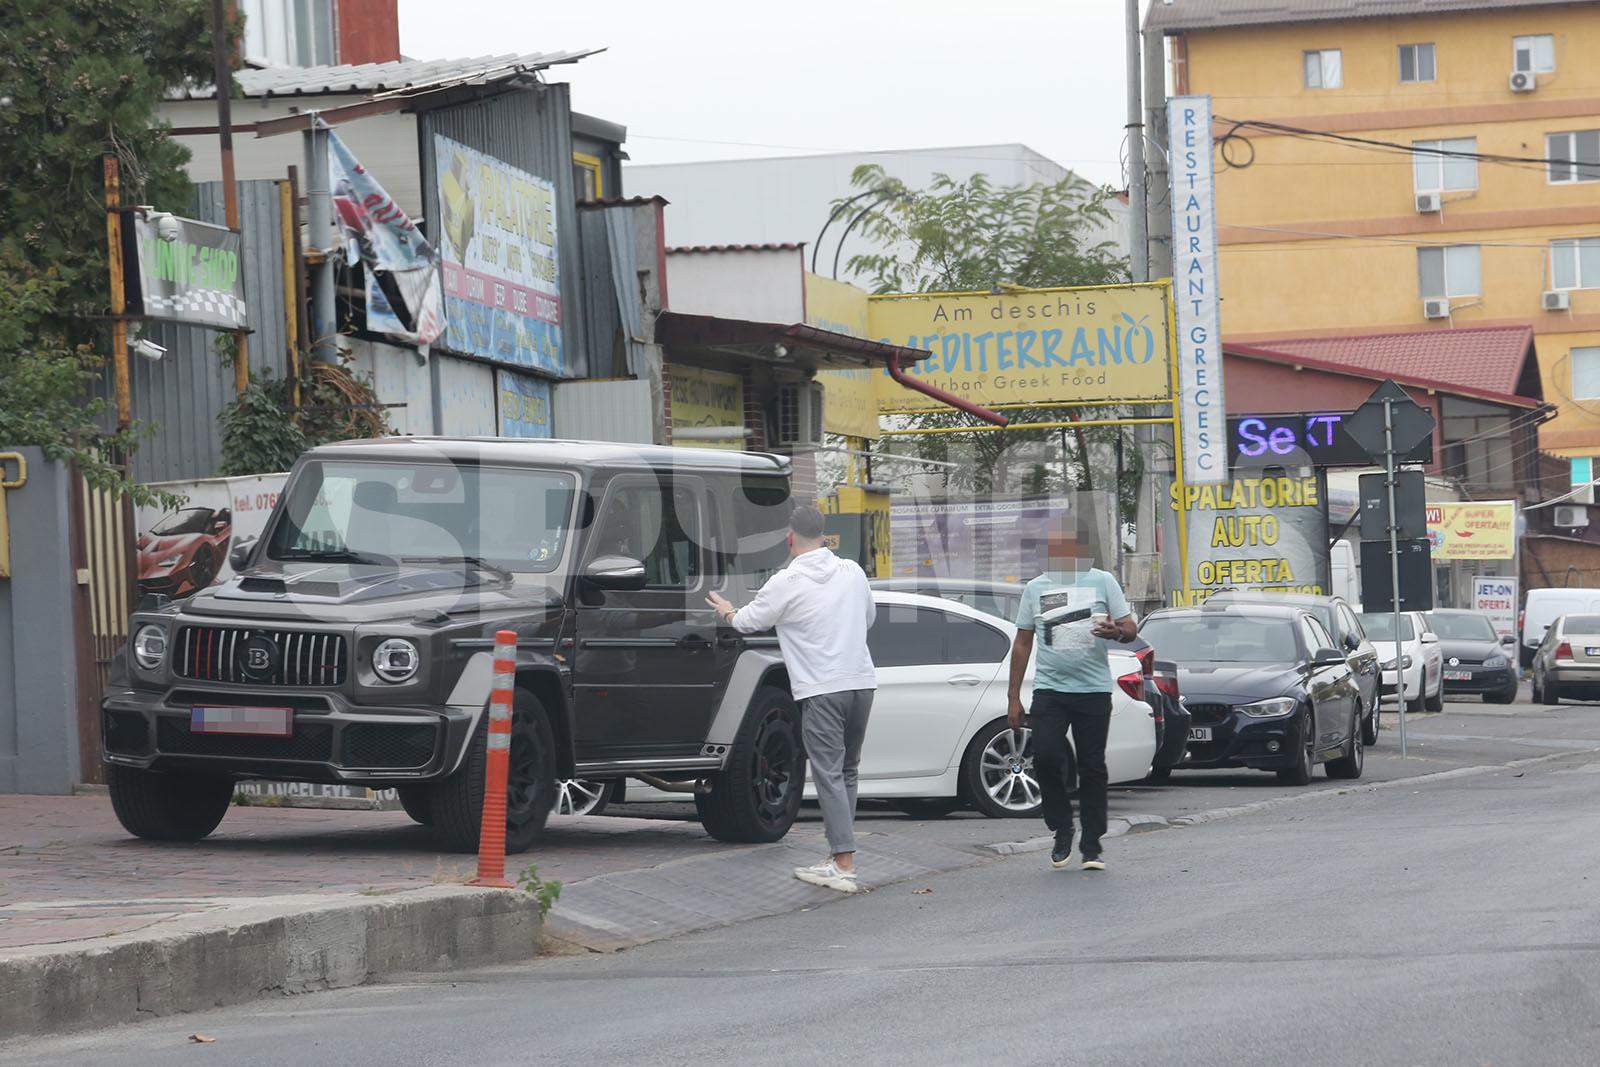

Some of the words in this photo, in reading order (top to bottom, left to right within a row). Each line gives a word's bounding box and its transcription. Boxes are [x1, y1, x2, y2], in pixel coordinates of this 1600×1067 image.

[1183, 107, 1204, 316] RESTAURANT
[199, 246, 238, 293] SHOP
[933, 304, 972, 322] Am
[991, 297, 1097, 320] deschis
[994, 375, 1050, 390] Greek
[1061, 371, 1107, 387] Food
[1190, 326, 1213, 470] GRECESC
[234, 495, 252, 512] tel.
[1169, 476, 1319, 511] SPALATORIE
[1426, 509, 1440, 522] W!
[1211, 515, 1280, 548] AUTO
[1198, 559, 1294, 585] OFERTA
[1478, 584, 1513, 596] JET-ON
[1477, 600, 1511, 610] OFERTA
